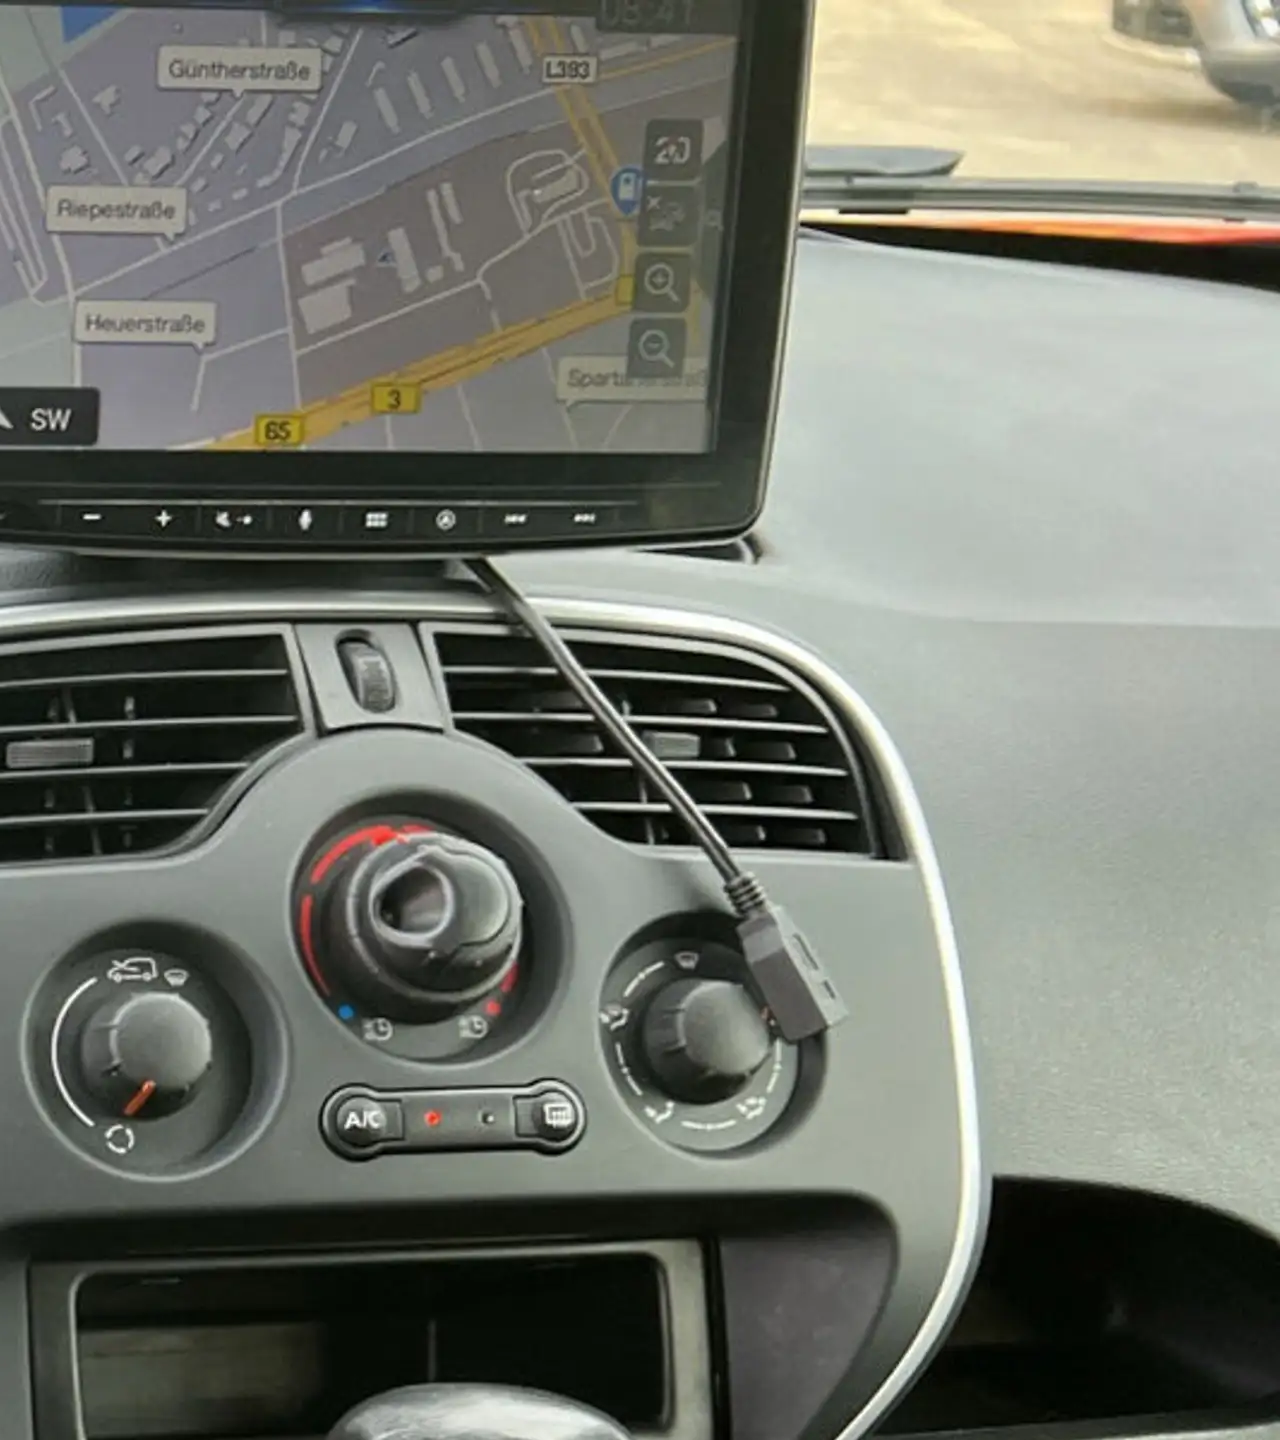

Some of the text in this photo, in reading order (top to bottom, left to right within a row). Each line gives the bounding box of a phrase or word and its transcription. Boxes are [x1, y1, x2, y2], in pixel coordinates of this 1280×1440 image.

[168, 59, 312, 81] Güntherstraße
[57, 198, 177, 221] Riepestraße
[85, 313, 206, 333] Heuerstraße
[387, 389, 402, 410] 3
[30, 407, 72, 431] SW
[343, 1110, 382, 1130] A/C
